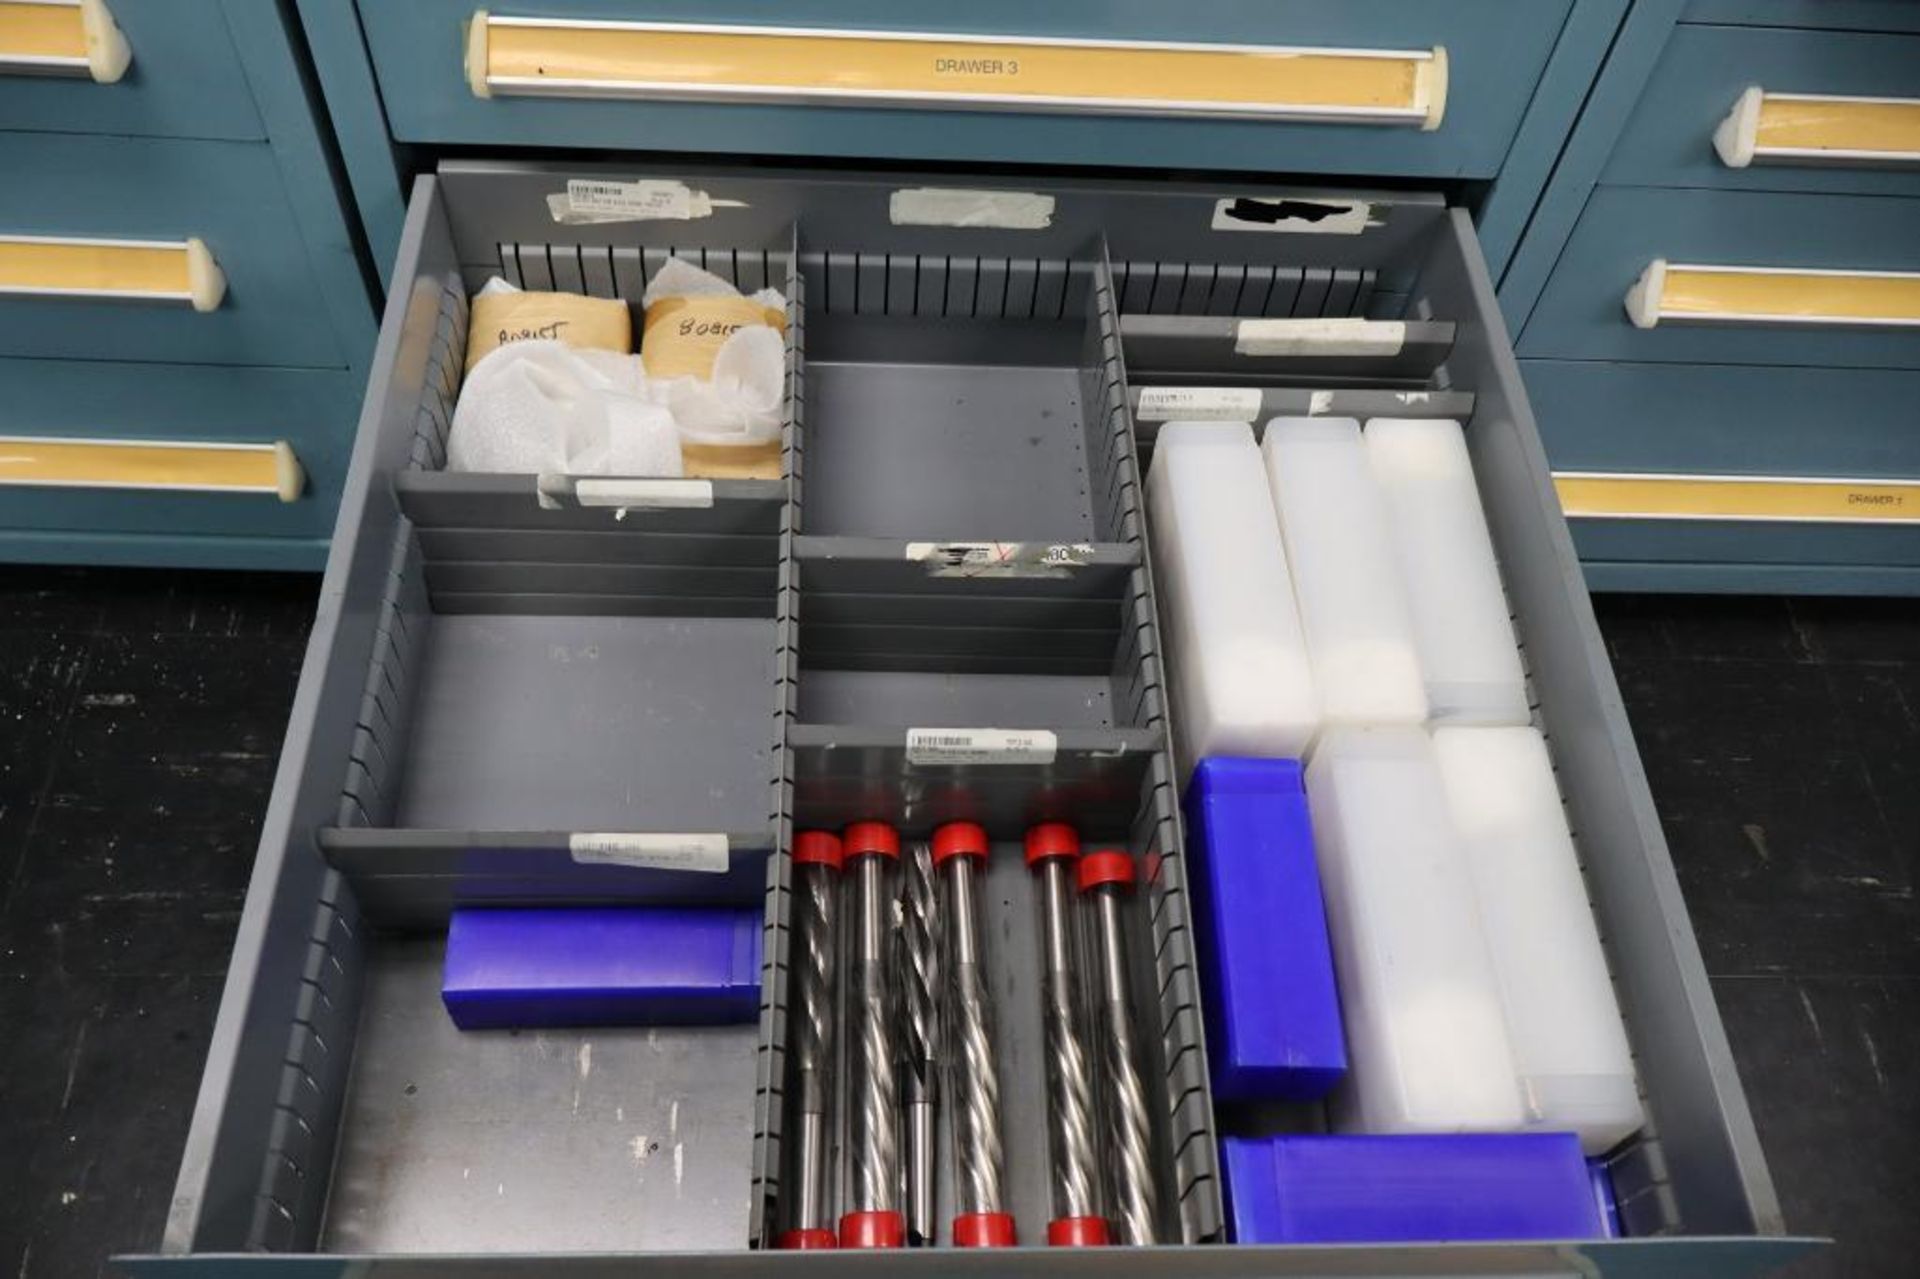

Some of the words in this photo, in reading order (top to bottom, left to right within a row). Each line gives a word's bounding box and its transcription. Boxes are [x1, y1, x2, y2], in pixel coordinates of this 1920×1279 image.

[935, 59, 1003, 74] DRAWER
[1007, 60, 1018, 75] 3
[1848, 493, 1894, 505] DRAWER
